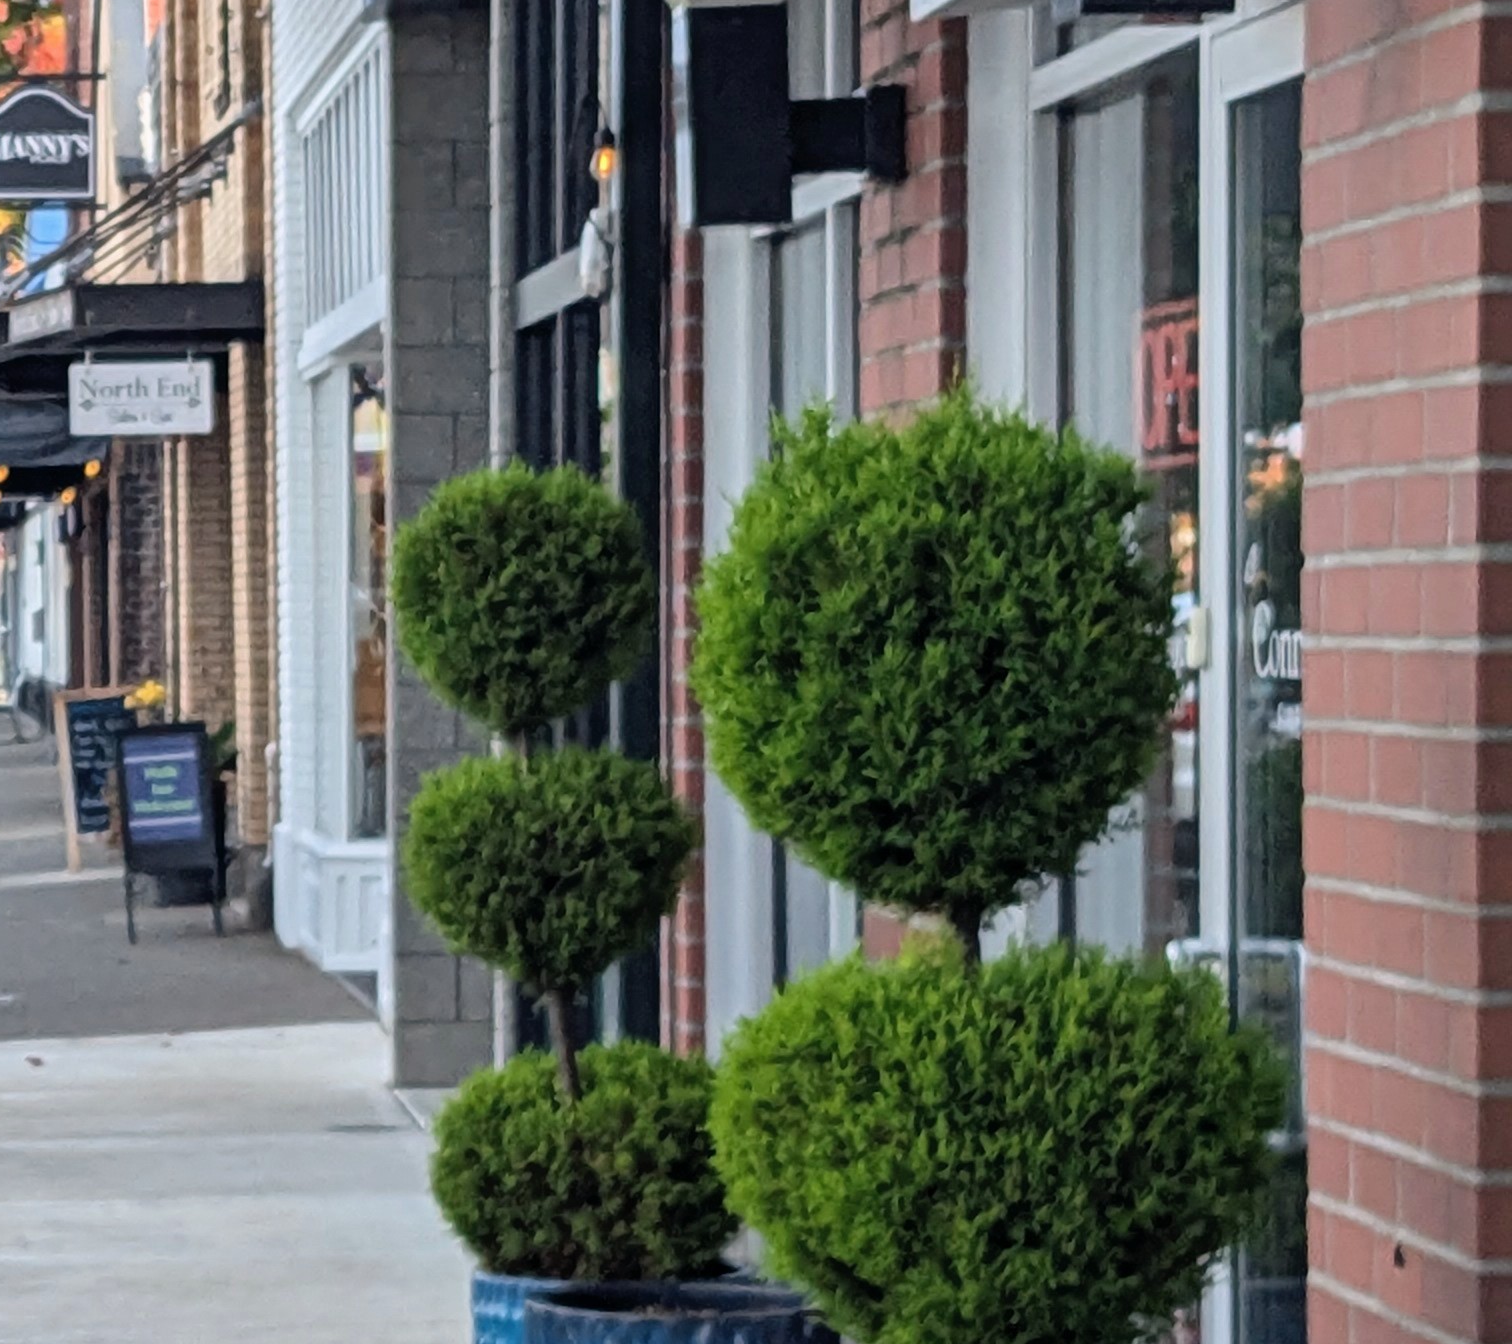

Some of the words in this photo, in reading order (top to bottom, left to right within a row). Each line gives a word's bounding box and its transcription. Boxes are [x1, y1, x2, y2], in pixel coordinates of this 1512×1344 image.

[79, 376, 150, 399] North
[157, 375, 201, 399] End
[1252, 599, 1302, 679] Conn
